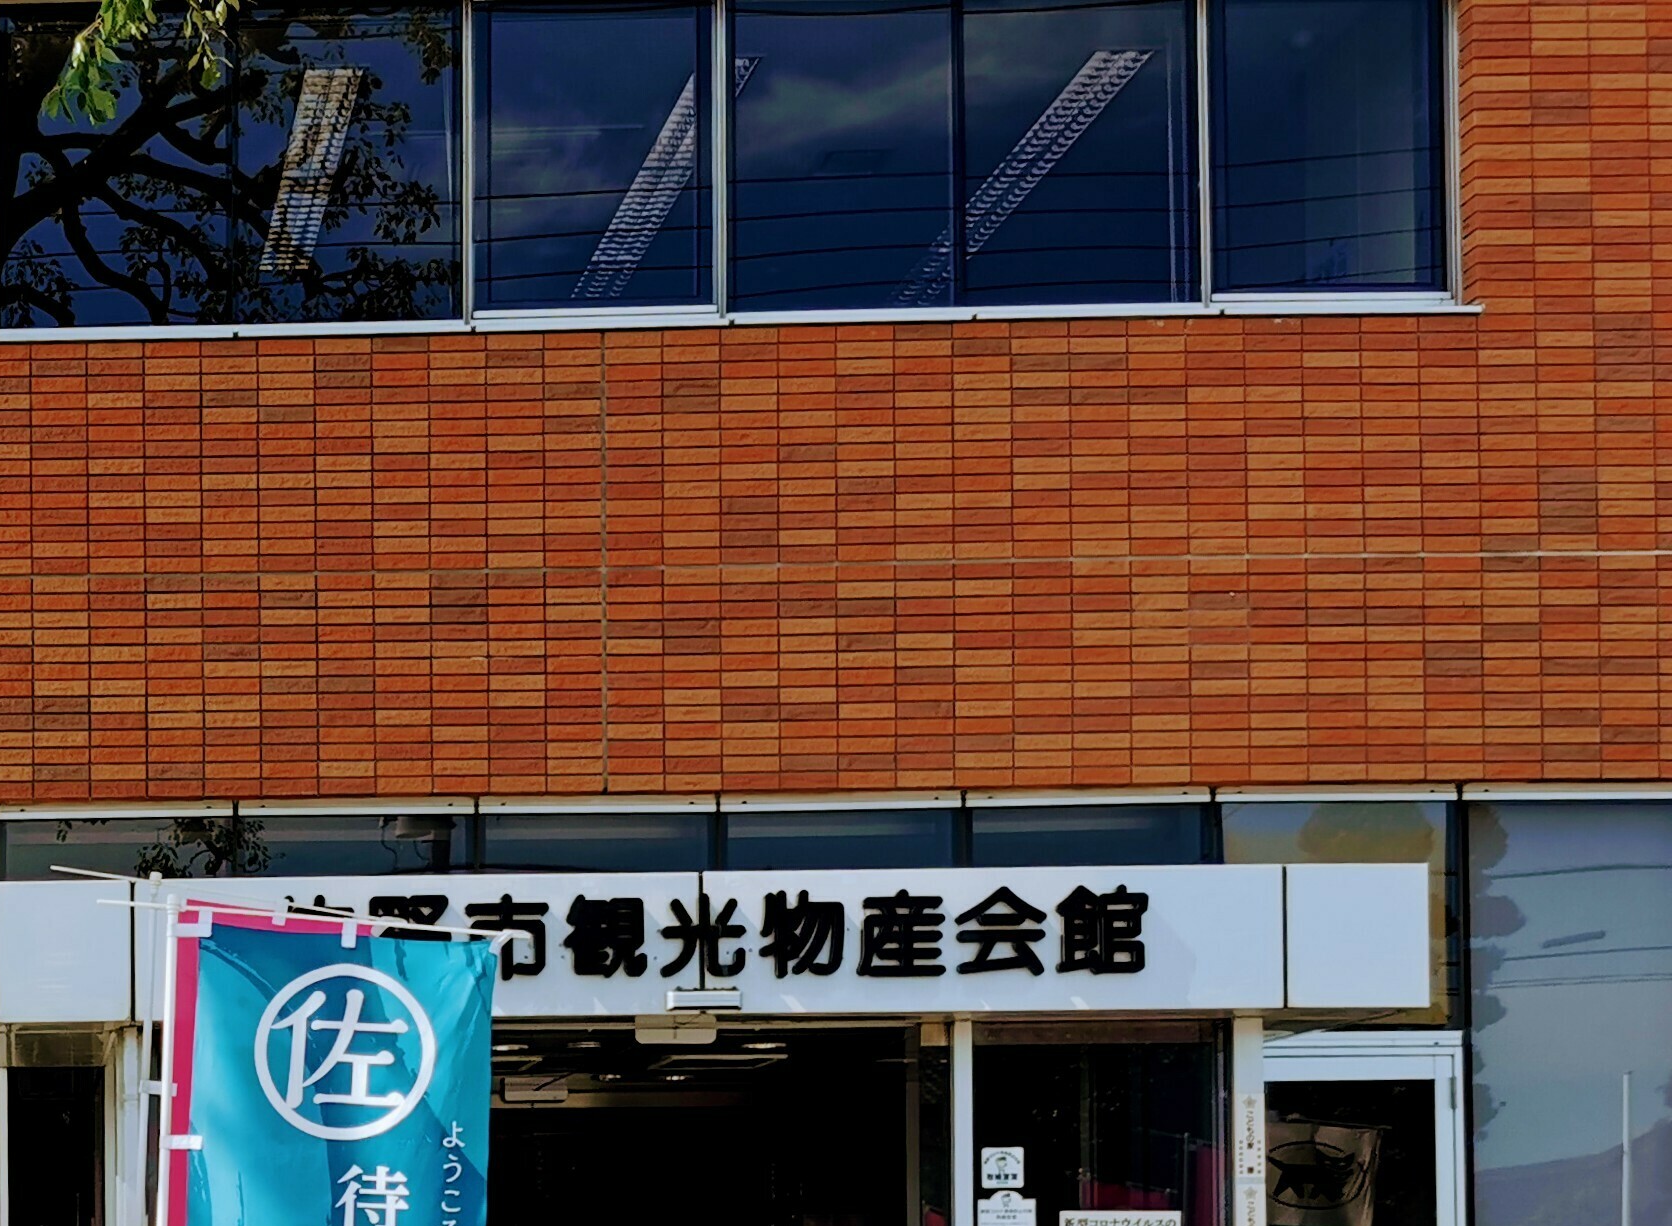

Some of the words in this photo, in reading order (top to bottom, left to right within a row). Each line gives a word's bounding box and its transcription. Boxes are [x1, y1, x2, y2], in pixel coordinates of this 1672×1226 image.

[285, 885, 1150, 981] 野市観光物産会館
[270, 988, 410, 1110] 佐
